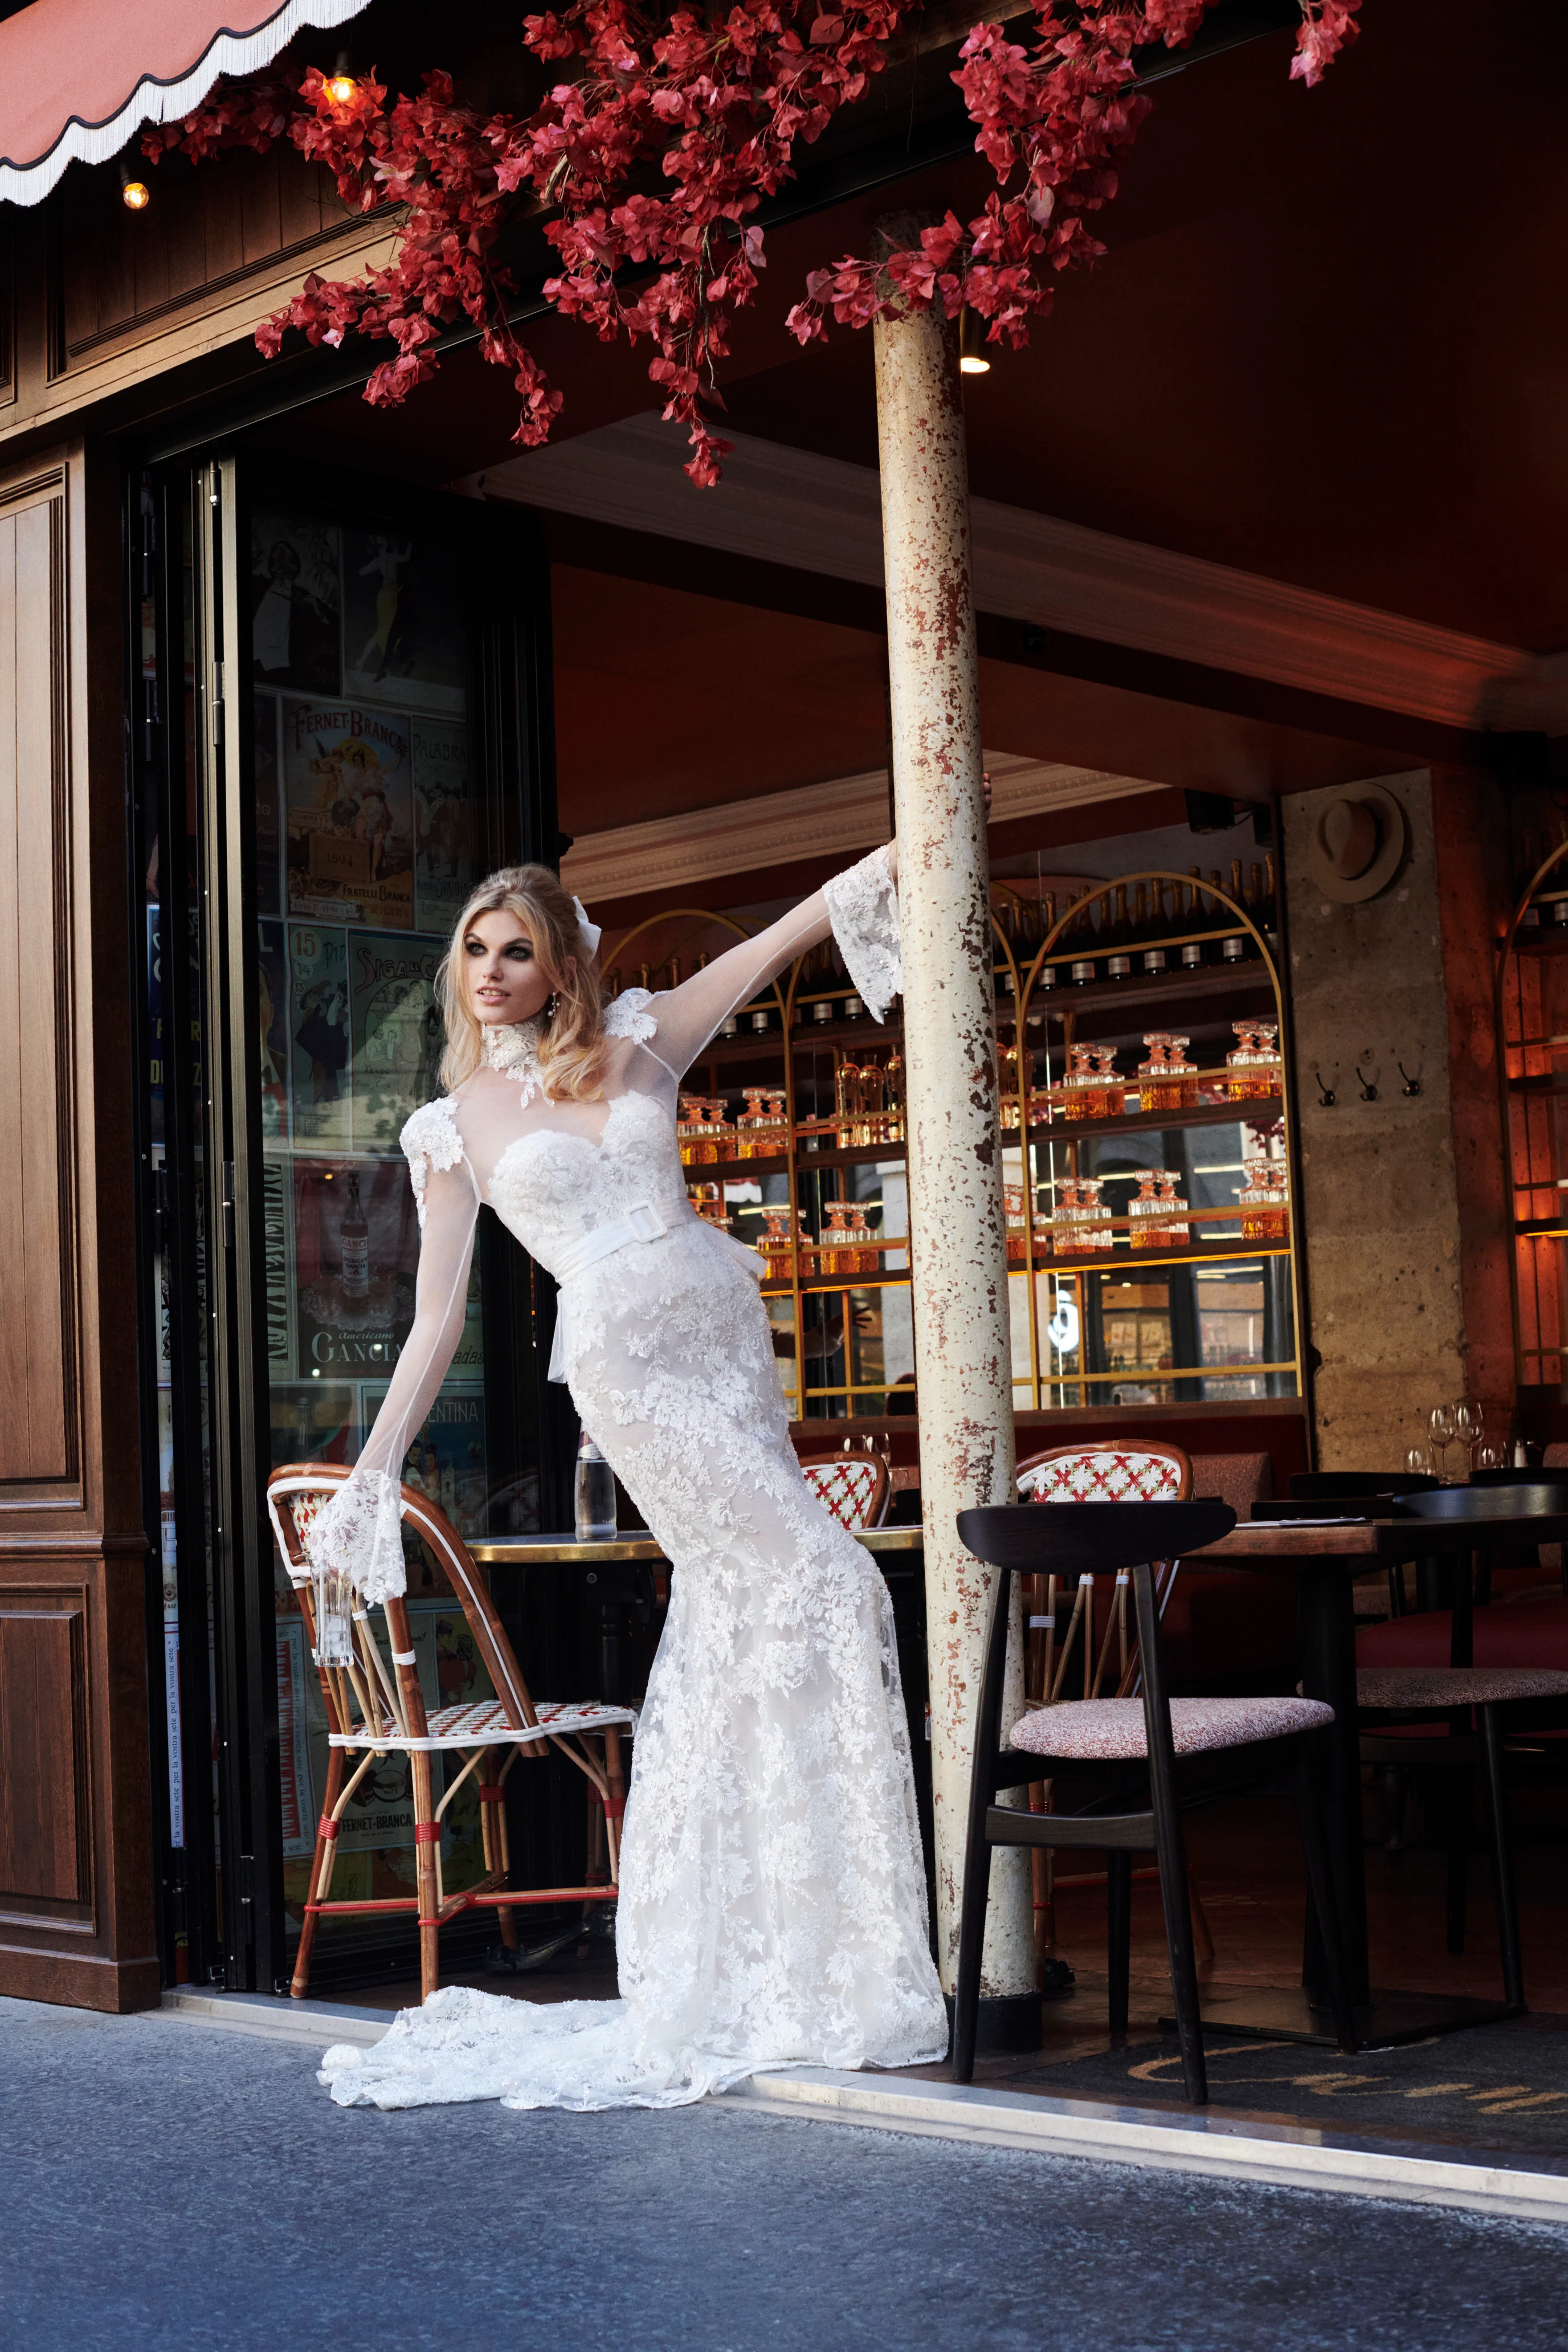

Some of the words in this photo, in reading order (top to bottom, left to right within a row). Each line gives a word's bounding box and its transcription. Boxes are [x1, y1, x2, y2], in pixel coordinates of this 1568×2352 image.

[327, 853, 353, 867] 1894
[342, 883, 377, 899] FRATELLI
[379, 885, 411, 903] BRANCA
[369, 904, 410, 918] MILANO
[295, 932, 316, 957] 15
[297, 964, 313, 976] 14
[354, 948, 407, 995] SIGA
[295, 982, 305, 993] 13
[338, 1331, 395, 1340] Americano
[343, 1813, 413, 1832] FERNET-BRANCA
